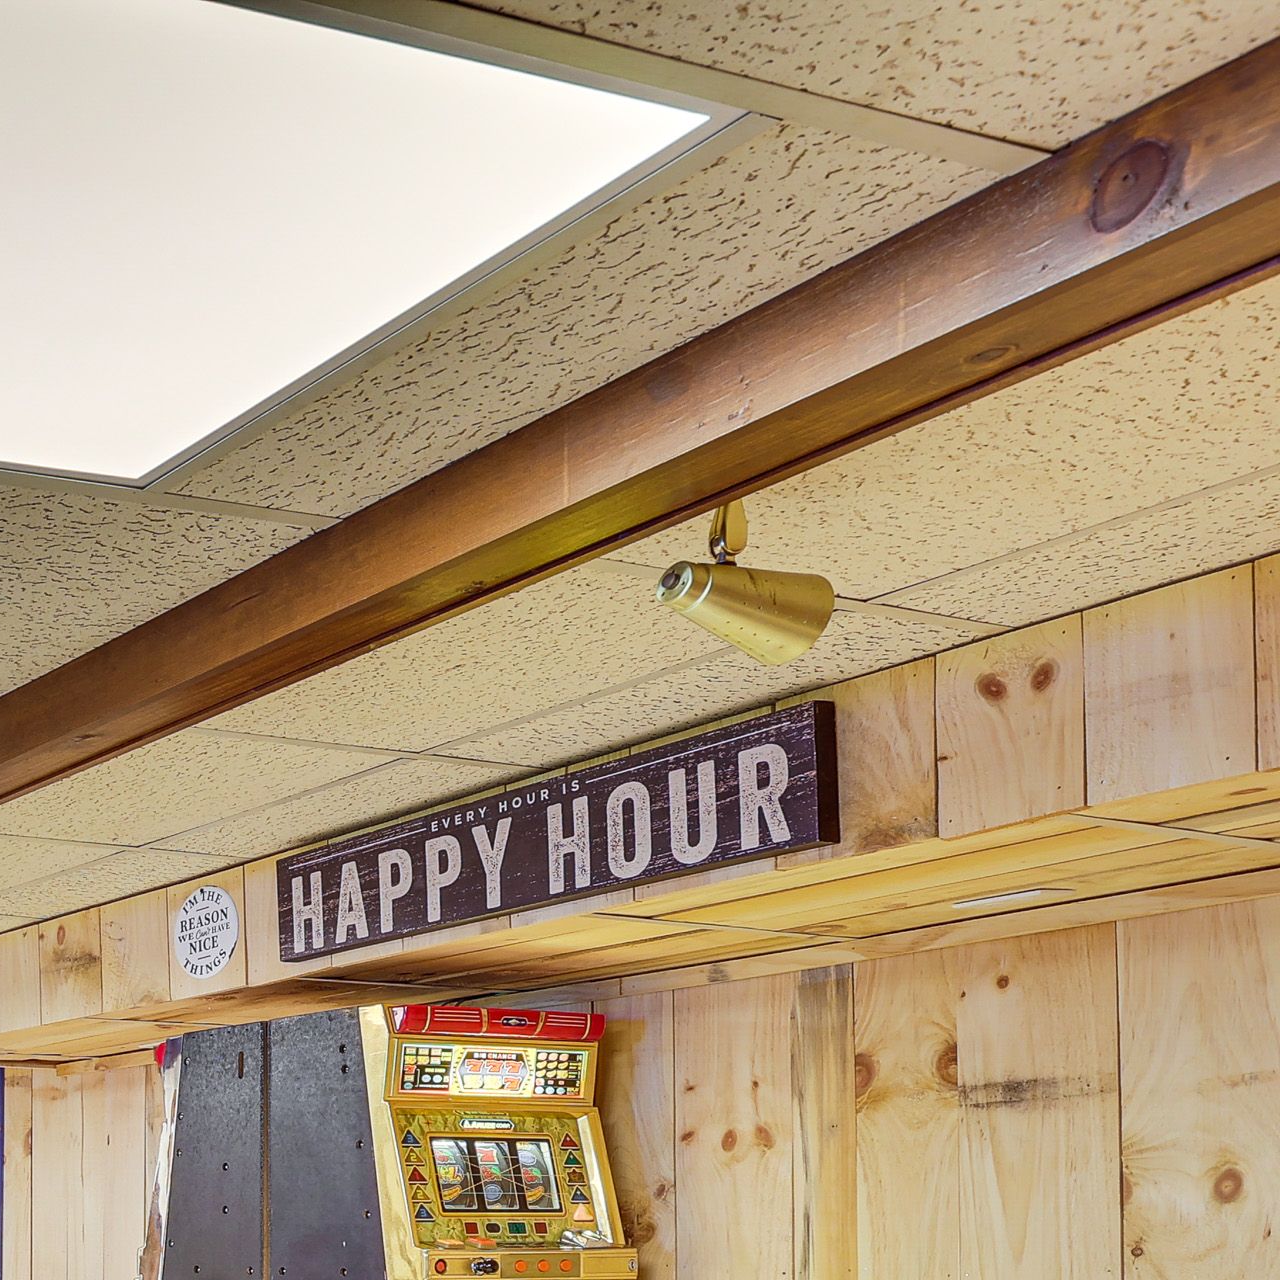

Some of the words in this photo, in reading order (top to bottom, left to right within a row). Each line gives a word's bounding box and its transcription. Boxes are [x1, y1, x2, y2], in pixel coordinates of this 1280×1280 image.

[430, 805, 488, 833] EVERY
[498, 788, 550, 814] HOUR
[562, 778, 582, 795] IS
[291, 815, 513, 955] HAPPY
[546, 742, 792, 897] HOUR
[182, 894, 199, 915] I'M
[200, 890, 223, 905] THE
[180, 907, 229, 933] REASON
[178, 932, 195, 944] WE
[211, 922, 231, 934] HAVE
[189, 935, 219, 955] NICE
[183, 948, 227, 976] THINGS
[410, 1153, 417, 1161] 2
[416, 1190, 423, 1199] 2
[420, 1208, 427, 1217] 3
